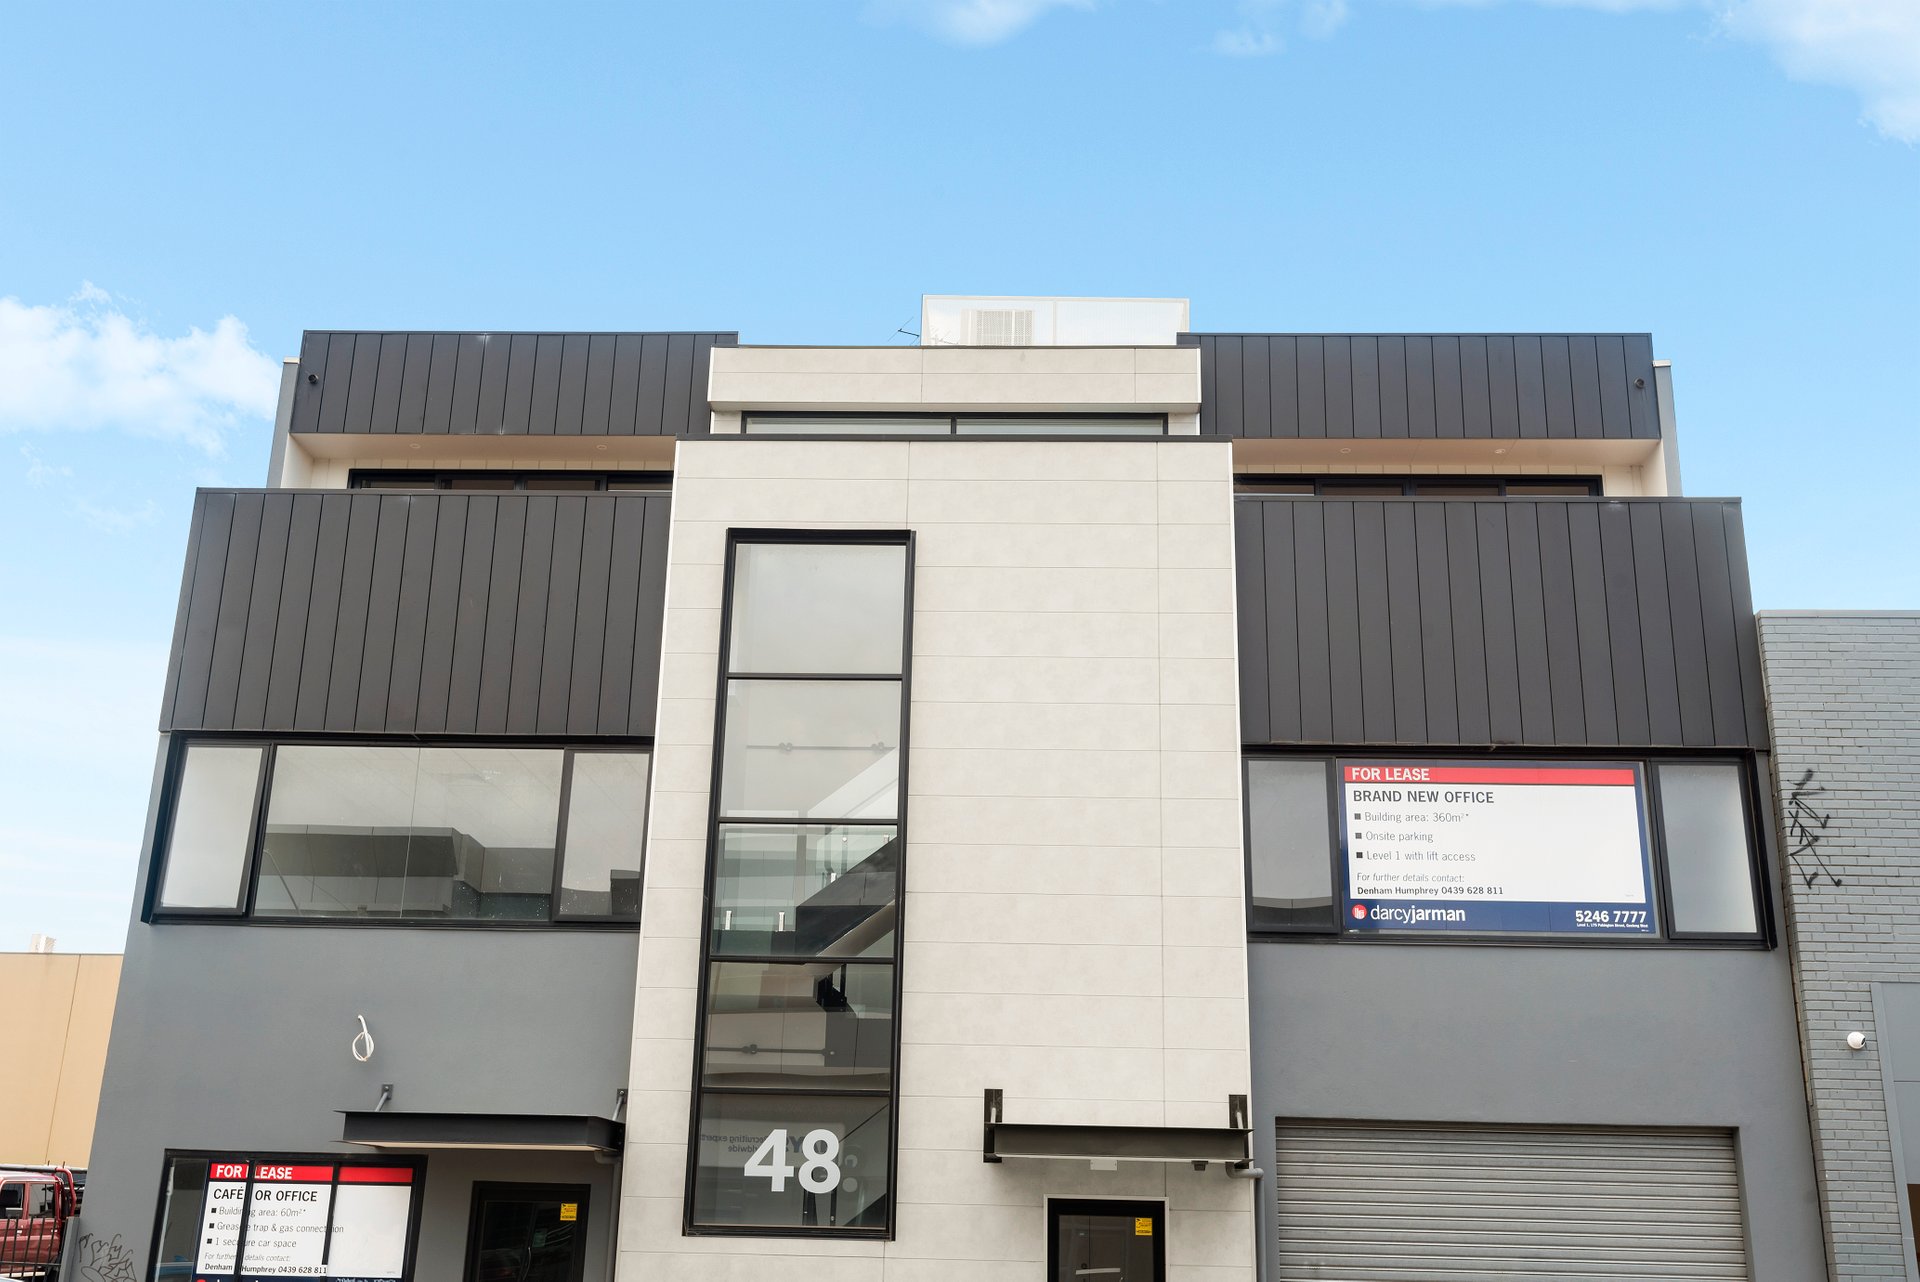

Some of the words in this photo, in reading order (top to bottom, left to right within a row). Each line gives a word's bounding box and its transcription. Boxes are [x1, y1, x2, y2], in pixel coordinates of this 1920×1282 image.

[1352, 767, 1381, 780] FOR
[1385, 768, 1430, 781] LEASE
[1353, 790, 1402, 802] BRAND
[1407, 790, 1439, 802] NEW
[1444, 791, 1494, 803] OFFICE
[1365, 812, 1401, 823] Building
[1405, 813, 1429, 822] area:
[1365, 832, 1395, 841] Onsite
[1399, 832, 1433, 843] parking
[1367, 851, 1392, 860] Level
[1395, 851, 1400, 860] 1
[1404, 851, 1424, 861] with
[1427, 851, 1438, 861] lift
[1441, 853, 1476, 862] access
[1357, 873, 1370, 881] For
[1373, 873, 1400, 882] further
[1403, 873, 1429, 882] details
[1432, 874, 1465, 883] contact:
[1357, 886, 1393, 895] Denham
[1395, 886, 1439, 896] Humphrey
[1441, 886, 1464, 895] 0439
[1467, 886, 1484, 895] 628
[1487, 886, 1503, 895] 811
[1370, 904, 1466, 924] darcyjarman
[1575, 910, 1609, 923] 5246
[1613, 910, 1647, 923] 7777
[744, 1129, 841, 1194] 48
[216, 1165, 242, 1178] FOR
[246, 1165, 293, 1179] LEASE
[213, 1186, 244, 1200] CAFÉ
[255, 1190, 271, 1201] OR
[276, 1190, 317, 1202] OFFICE
[258, 1208, 277, 1216] area:
[253, 1223, 268, 1232] trap
[271, 1223, 277, 1231] &
[279, 1225, 293, 1233] gas
[215, 1237, 219, 1245] 1
[258, 1239, 270, 1247] car
[274, 1240, 297, 1248] space
[205, 1252, 215, 1260] For
[217, 1252, 237, 1260] further
[205, 1263, 232, 1271] Denham
[242, 1265, 275, 1274] Humphrey
[278, 1266, 296, 1274] 0439
[298, 1266, 312, 1274] 628
